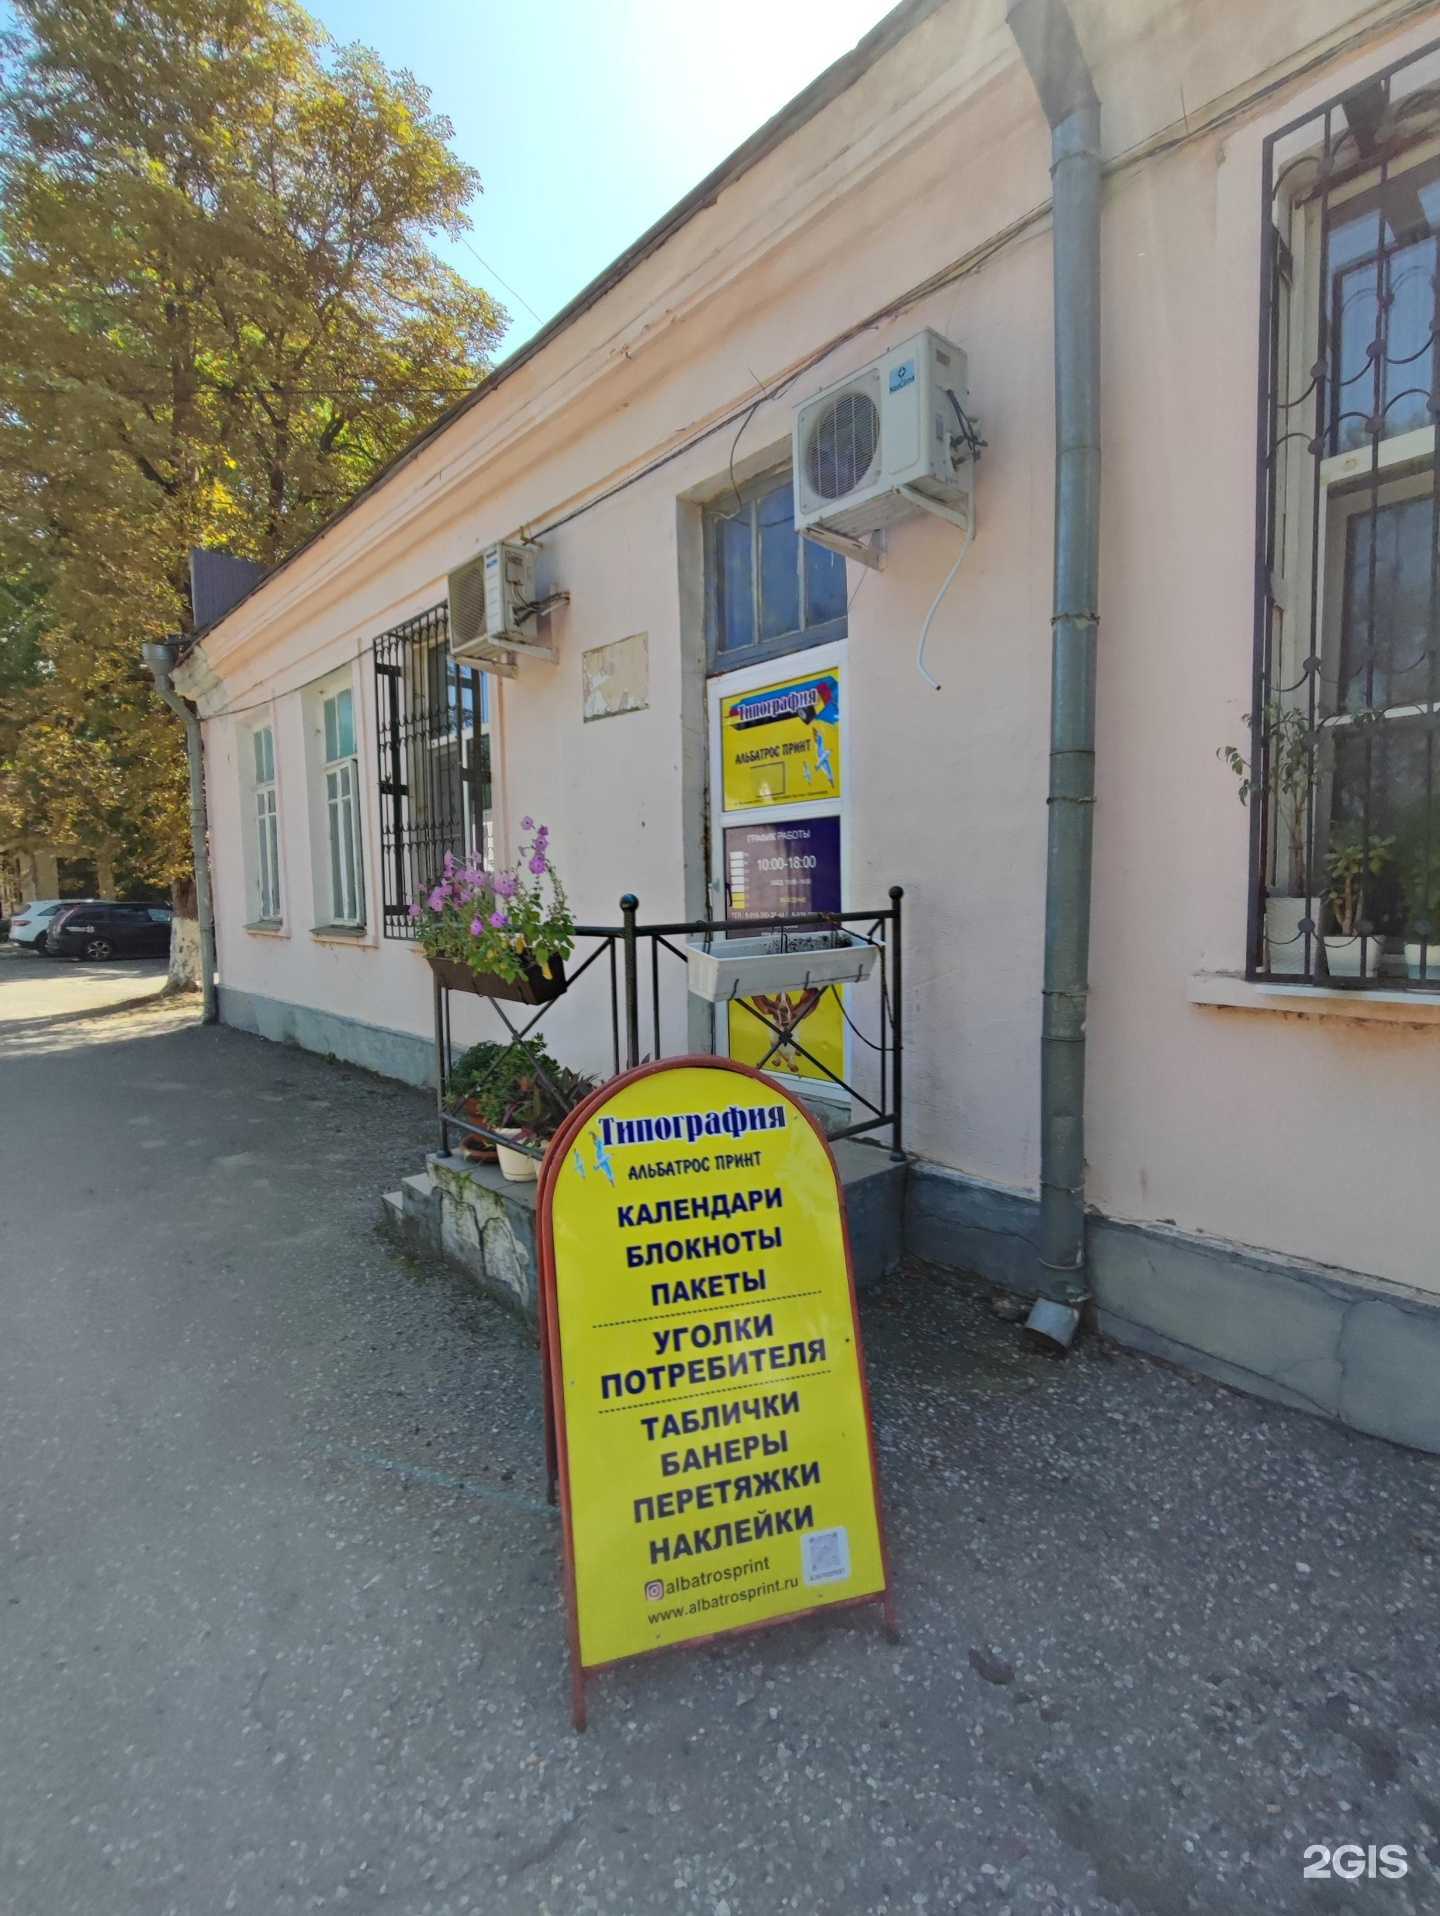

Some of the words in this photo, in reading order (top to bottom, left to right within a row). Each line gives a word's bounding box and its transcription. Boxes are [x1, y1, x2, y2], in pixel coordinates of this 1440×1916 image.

[737, 688, 818, 723] Типография
[735, 745, 780, 765] АЛЬБАТРОС
[782, 739, 812, 758] ПРИНТ
[777, 829, 811, 840] РАБОТЫ
[598, 1105, 787, 1147] Типография
[628, 1158, 710, 1181] АЛЬБАТРОС
[716, 1151, 762, 1171] ПРИНТ
[617, 1188, 783, 1228] КАЛЕНДАРИ
[626, 1227, 783, 1268] БЛОКНОТЫ
[651, 1269, 767, 1306] ПАКЕТЫ
[653, 1313, 774, 1355] УГОЛКИ
[601, 1339, 827, 1399] ПОТРЕБИТЕЛЯ
[641, 1391, 800, 1441] ТАБЛИЧКИ
[661, 1430, 788, 1477] БАНЕРЫ
[633, 1461, 821, 1523] ПЕРЕТЯЖКИ
[649, 1505, 814, 1564] НАКЛЕЙКИ
[666, 1556, 770, 1596] albatrosprint
[647, 1577, 799, 1624] www.albatrosprint.ru
